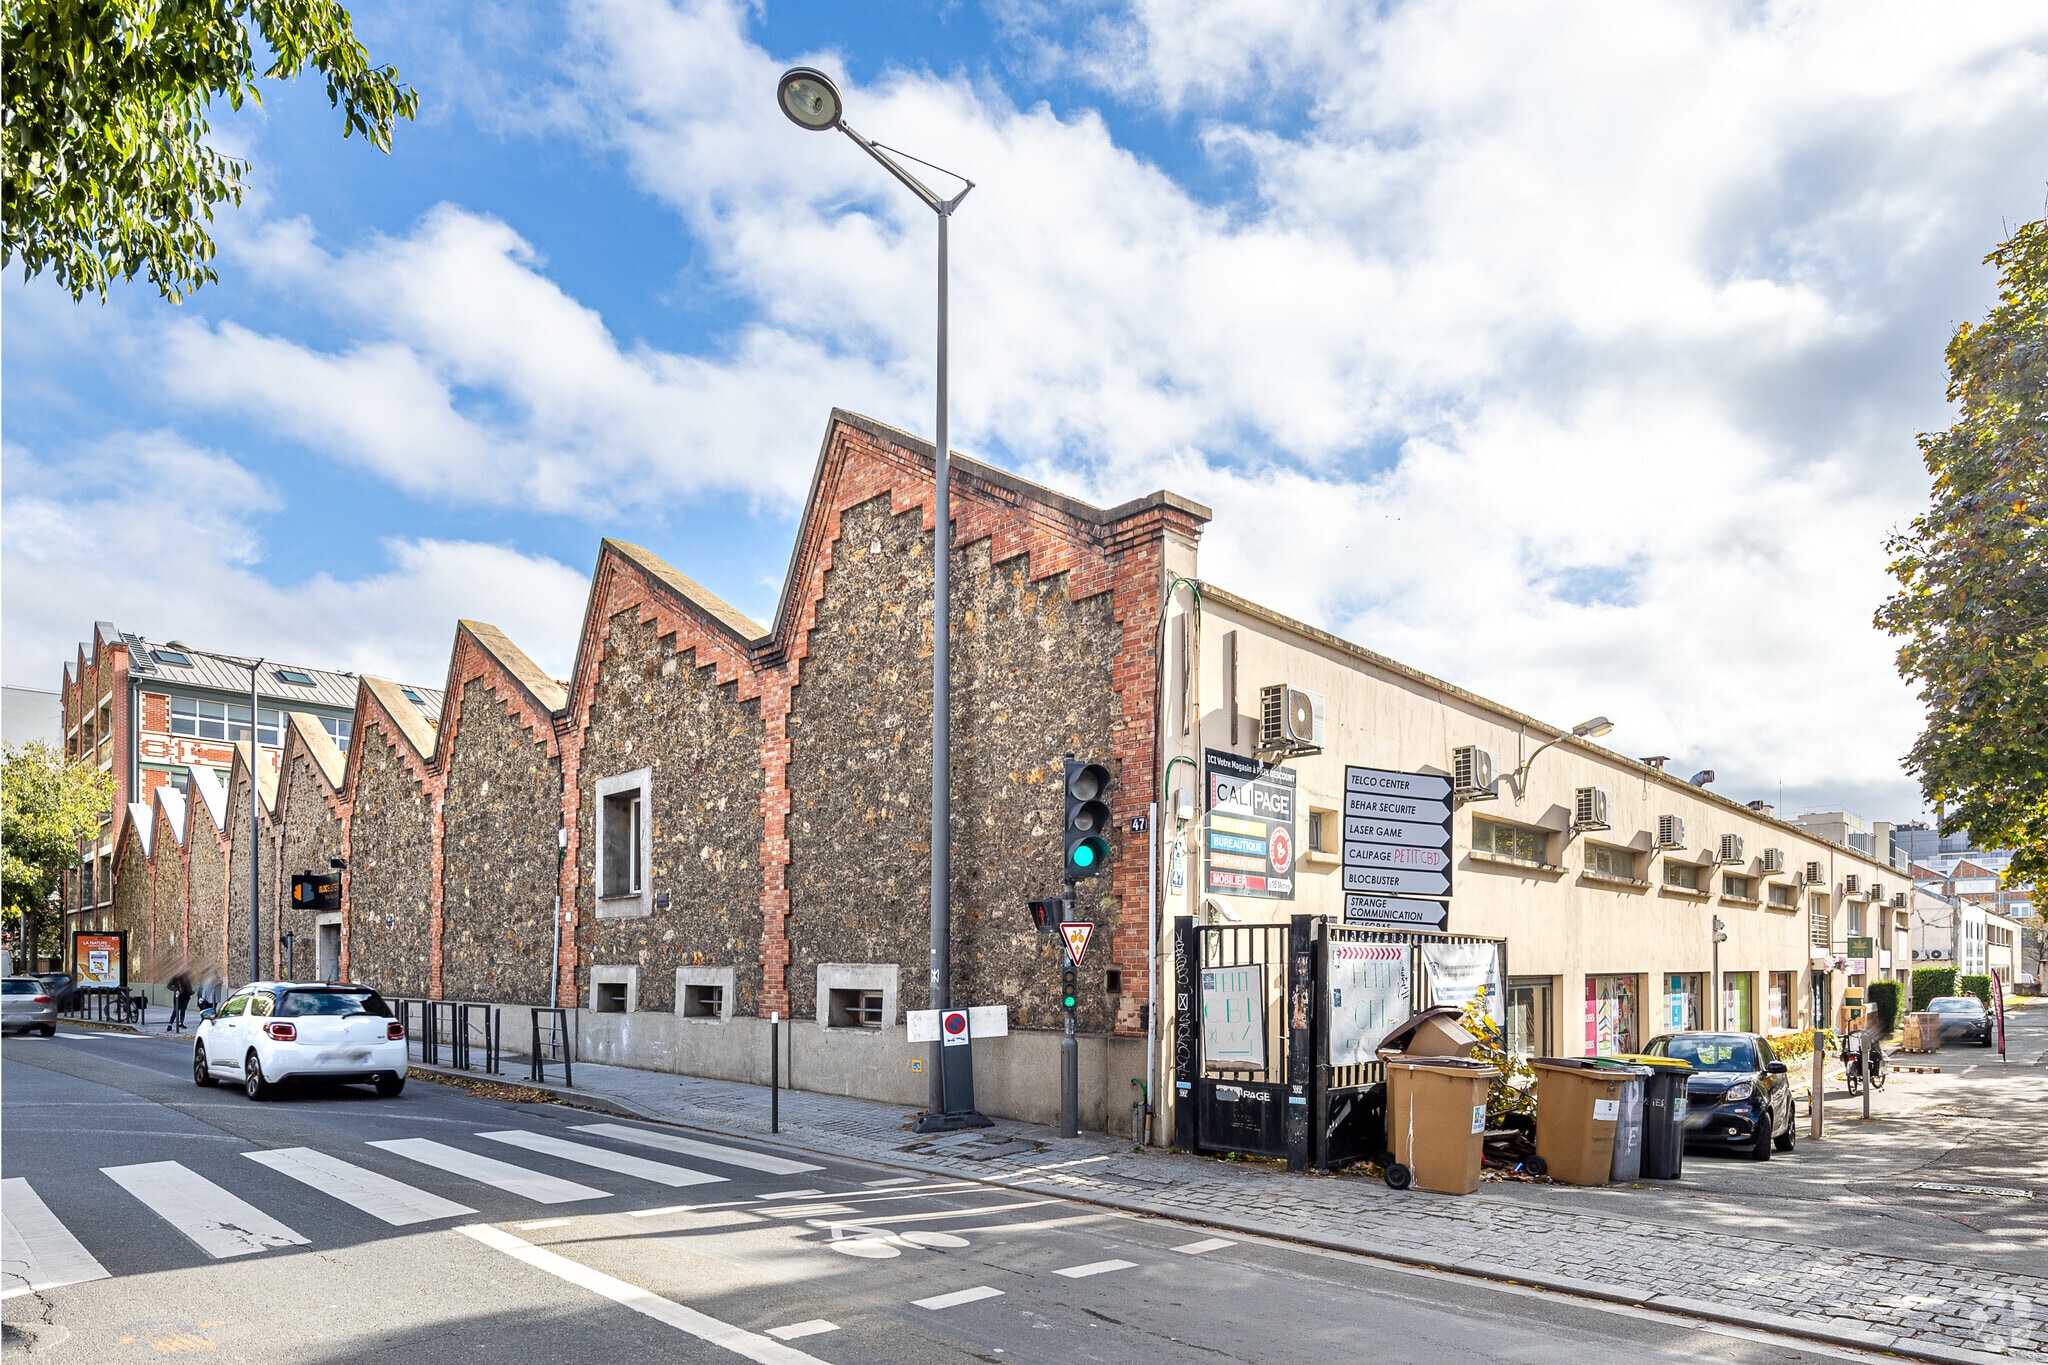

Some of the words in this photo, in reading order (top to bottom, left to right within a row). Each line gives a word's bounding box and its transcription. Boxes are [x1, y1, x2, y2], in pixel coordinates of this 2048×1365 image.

[1207, 754, 1217, 765] ICI
[1217, 757, 1232, 768] Votre
[1231, 760, 1252, 773] Magasin
[1351, 774, 1378, 787] TELCO
[1379, 778, 1410, 790] CENTER
[1350, 799, 1378, 811] BEHAR
[1379, 802, 1417, 815] SECURITE
[1132, 818, 1145, 831] 47
[1349, 824, 1374, 835] LASER
[1376, 827, 1403, 838] GAME
[1213, 836, 1263, 853] BUREAUTIQUE
[1213, 854, 1264, 870] INFORMATIQUE
[1348, 848, 1392, 862] CALIPAGE
[1393, 848, 1421, 864] PETIT
[1420, 851, 1440, 866] CBD
[1212, 872, 1247, 886] MOBILIER
[1348, 873, 1400, 886] BLOCBUSTER
[1350, 896, 1387, 908] STRANGE
[1350, 907, 1423, 921] COMMUNICATION
[1203, 997, 1260, 1024] CBD
